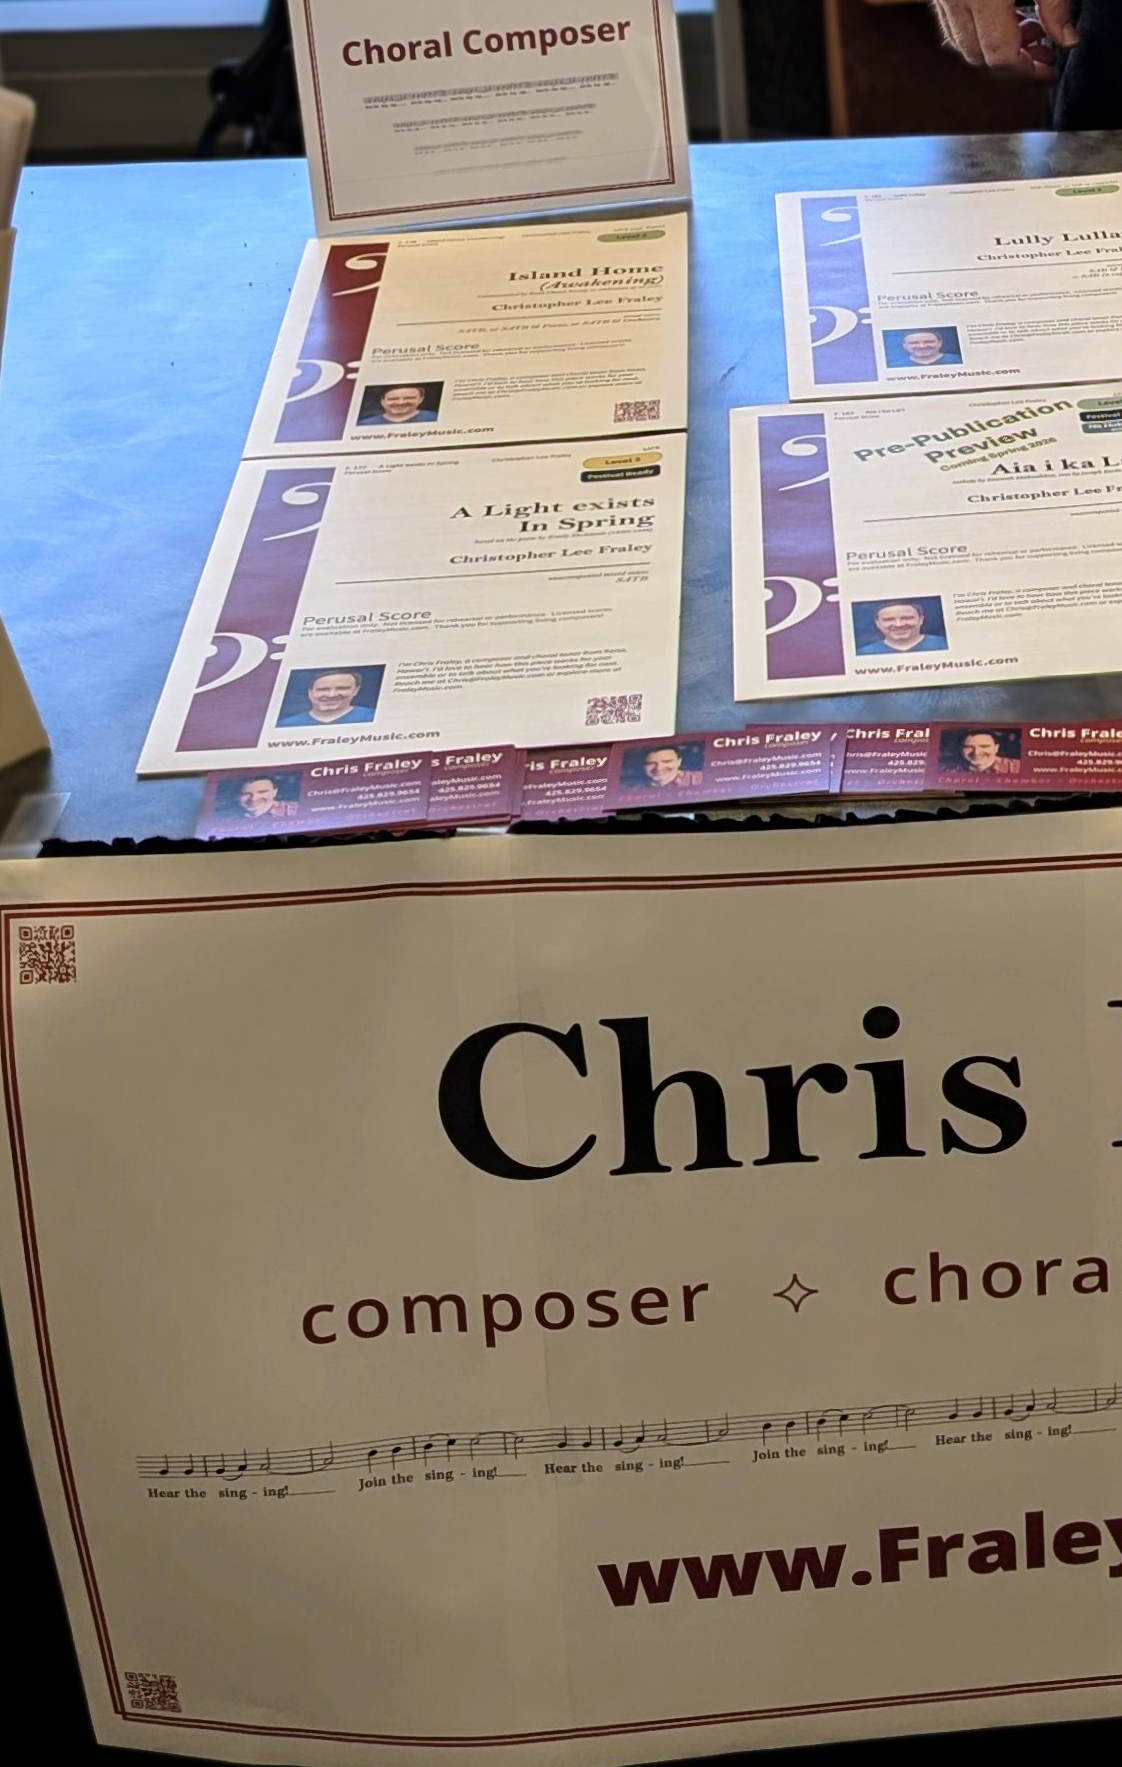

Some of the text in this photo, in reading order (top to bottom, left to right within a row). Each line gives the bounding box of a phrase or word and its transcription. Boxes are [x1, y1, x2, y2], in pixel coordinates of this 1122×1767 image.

[342, 19, 632, 66] Choral Composer
[994, 234, 1054, 246] Lully
[976, 250, 1062, 262] Christopher
[508, 265, 664, 281] Island Home
[539, 274, 664, 292] (Awakening)
[491, 295, 663, 311] Christopher Lee Fraley
[877, 291, 932, 302] Perusal
[936, 289, 979, 299] Score
[372, 343, 432, 355] Perusal
[435, 342, 480, 352] Score
[886, 367, 1021, 382] www.FraleyMusic.com
[853, 397, 1074, 463] Pre-Publication
[923, 426, 1038, 464] Preview
[991, 462, 1037, 476] Aia
[1045, 459, 1054, 472] i
[1060, 457, 1096, 471] ka
[966, 489, 1071, 503] Christopher
[1074, 486, 1102, 497] Lee
[450, 497, 655, 519] A Light exists
[519, 515, 655, 533] In Spring
[450, 544, 653, 565] Christopher Lee Fraley
[846, 547, 913, 562] Perusal
[917, 543, 968, 555] Score
[303, 609, 432, 627] Perusal Score
[854, 656, 1019, 676] www.FraleyMusic.com
[267, 729, 441, 750] www.FraleyMusic.com
[713, 729, 822, 750] Chris Fraley
[1029, 727, 1076, 740] Chris
[310, 758, 423, 778] Chris Fraley
[445, 751, 503, 768] Fraley
[550, 755, 608, 770] Fraley
[438, 1004, 1028, 1182] Chris
[301, 1280, 710, 1349] composer
[148, 1488, 181, 1499] Hear
[184, 1488, 206, 1499] the
[358, 1477, 387, 1492] Join
[391, 1473, 413, 1485] the
[544, 1463, 577, 1474] Hear
[582, 1462, 603, 1473] the
[752, 1449, 781, 1463] Join
[785, 1446, 806, 1458] the
[935, 1434, 967, 1446] Hear
[971, 1432, 993, 1443] the
